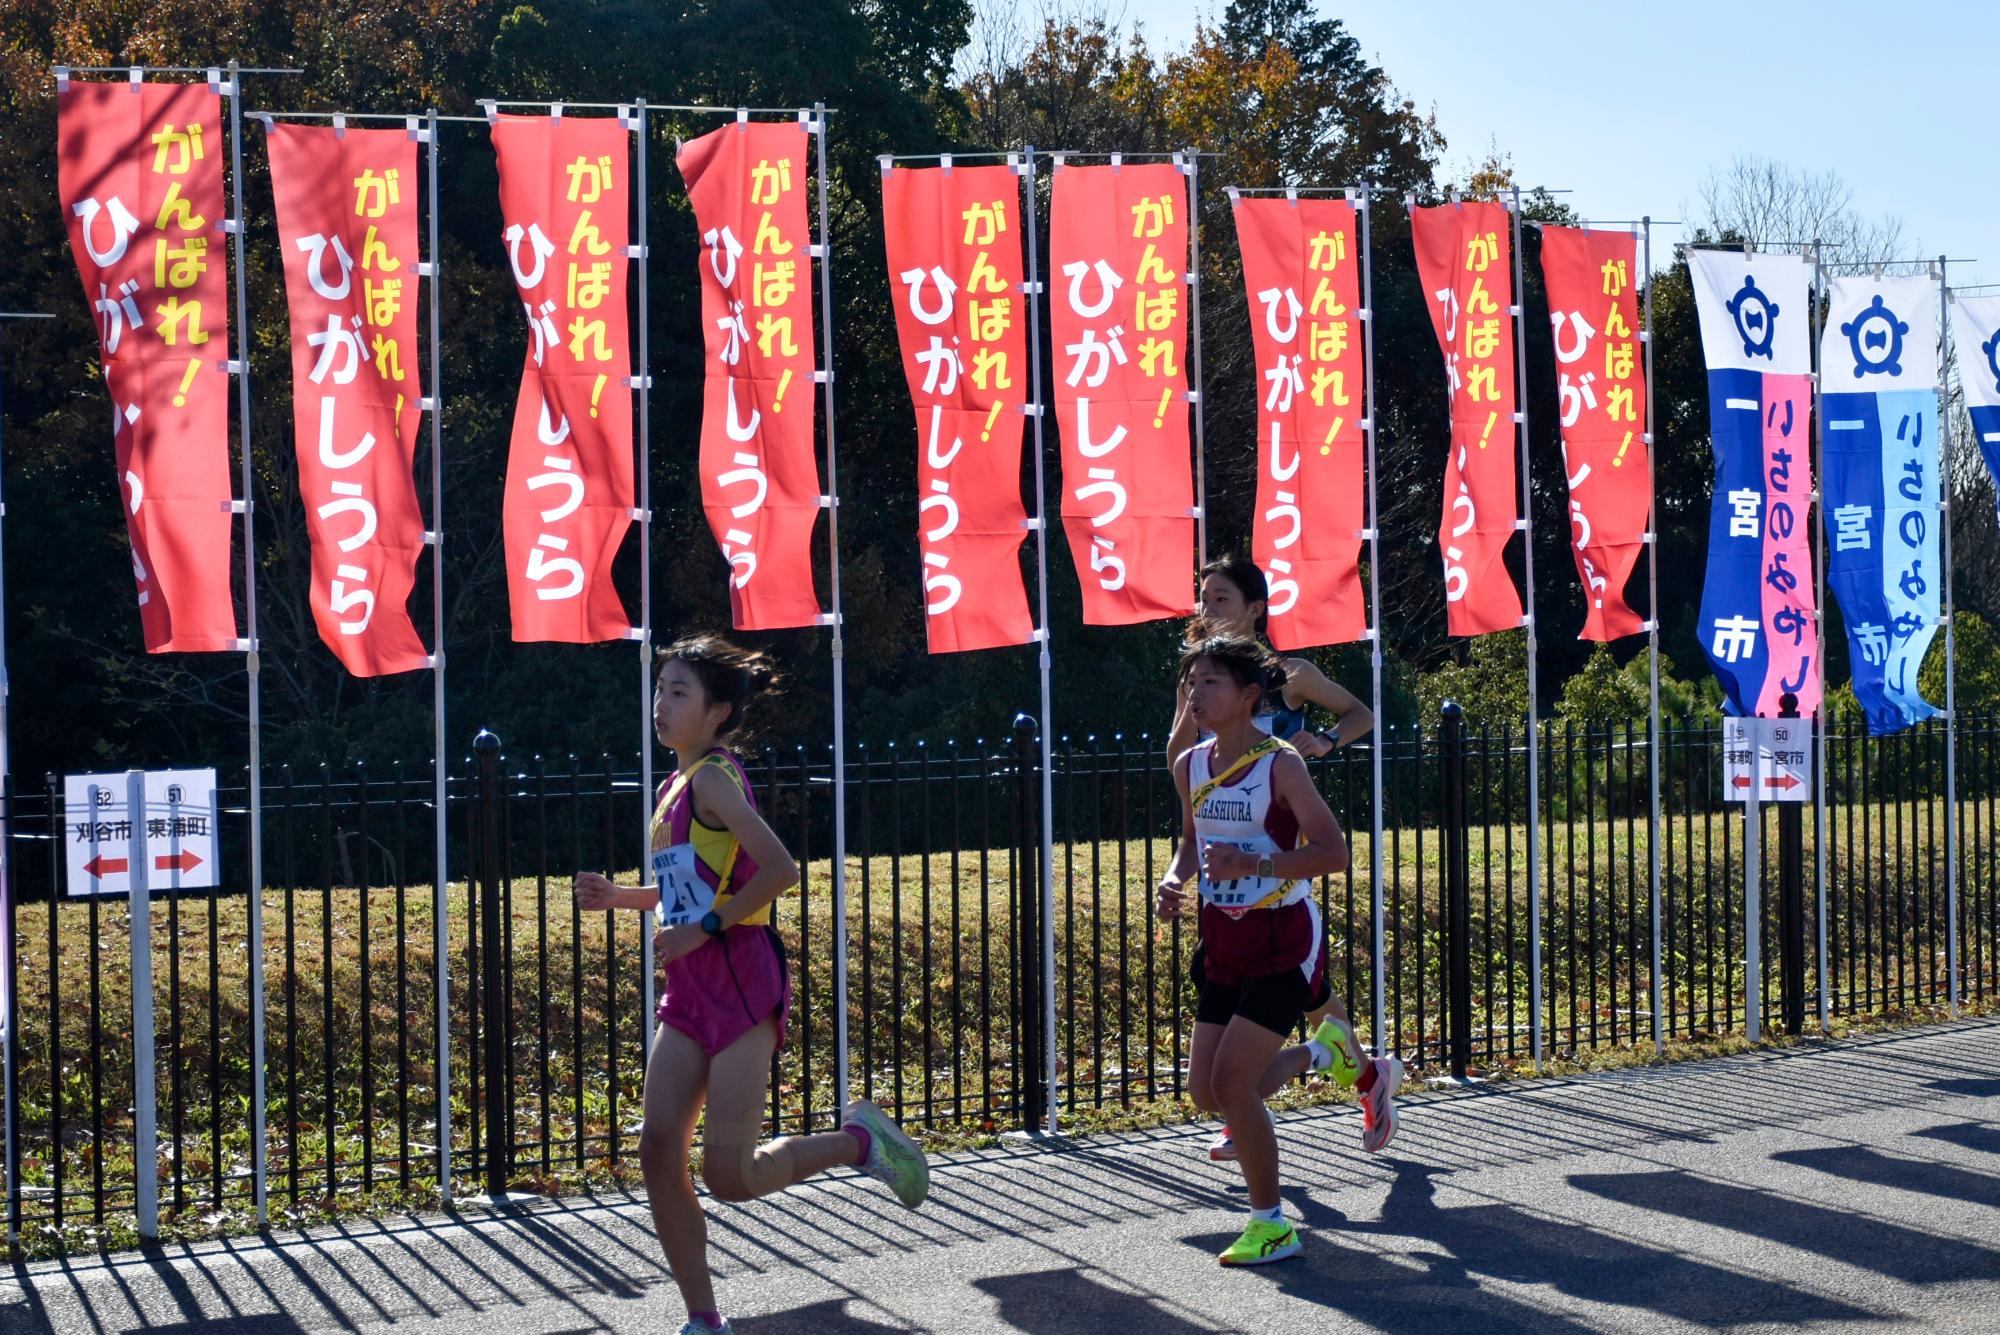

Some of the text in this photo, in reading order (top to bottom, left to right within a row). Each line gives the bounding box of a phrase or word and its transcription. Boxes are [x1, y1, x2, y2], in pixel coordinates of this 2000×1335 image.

[151, 123, 209, 407] がんばれ！
[566, 156, 613, 418] がんばれ！
[751, 158, 799, 413] がんばれ！
[962, 200, 1012, 442] がんばれ！
[1131, 194, 1178, 428] がんばれ！
[1309, 230, 1350, 455] がんばれ！
[1465, 231, 1501, 450] がんばれ！
[1601, 258, 1636, 467] がんばれ！
[296, 233, 378, 635] ひがしうら
[901, 266, 964, 616] ひがしうら
[1062, 258, 1129, 591] ひがしうら
[1258, 288, 1304, 616] ひがしうら
[1712, 398, 1761, 663] 一宮市
[1829, 419, 1888, 666] 一宮市
[76, 820, 132, 843] 刈谷市
[147, 816, 207, 838] 東浦町
[1761, 750, 1805, 765] 一宮市
